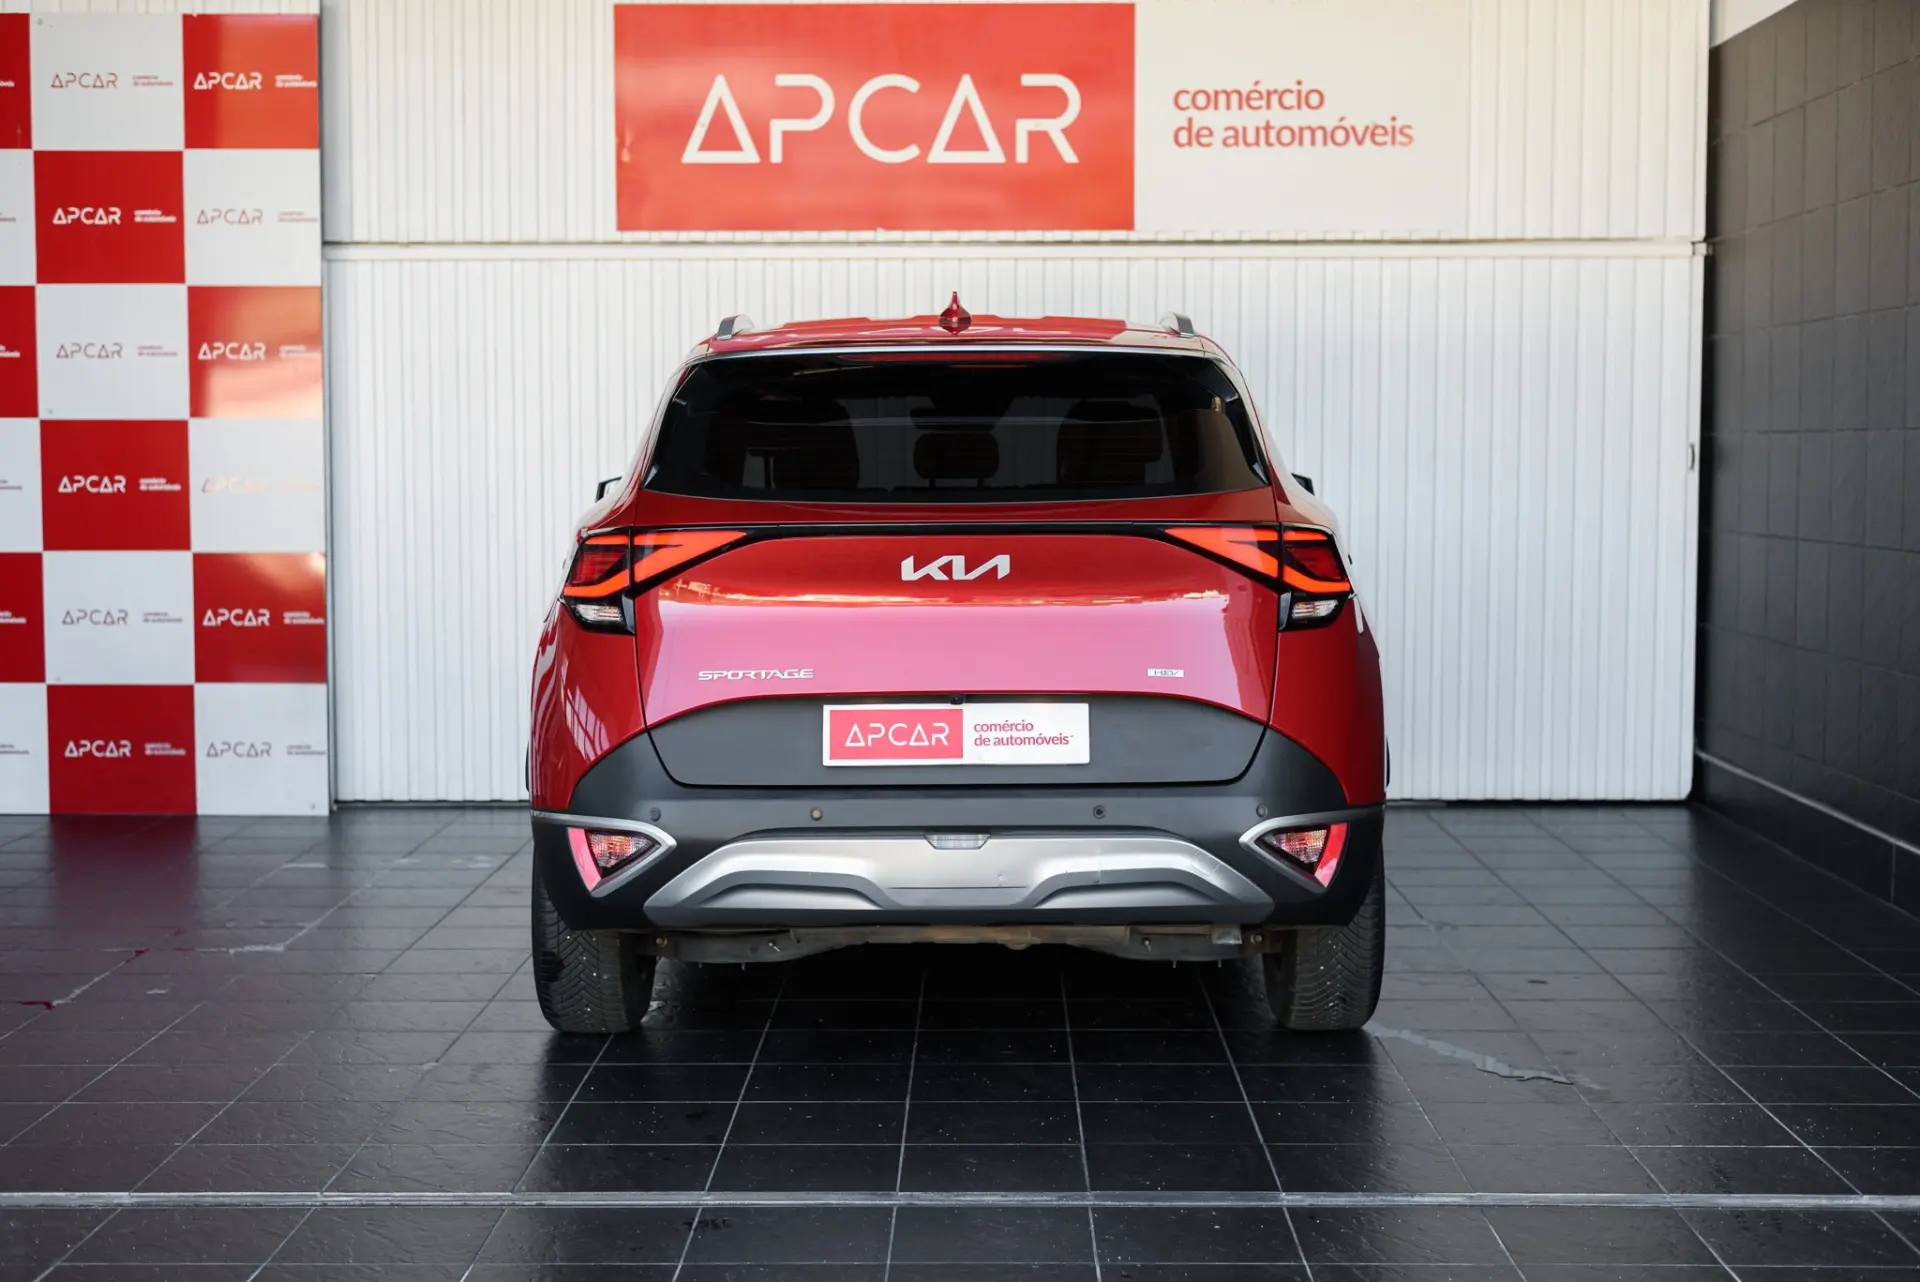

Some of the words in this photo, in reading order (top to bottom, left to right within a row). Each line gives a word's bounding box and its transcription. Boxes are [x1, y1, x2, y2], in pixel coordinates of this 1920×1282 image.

[193, 72, 263, 90] APCAR
[1173, 79, 1325, 112] comércio
[681, 73, 1082, 164] APCAR
[1173, 117, 1214, 148] de
[1221, 115, 1415, 148] automóveis
[52, 206, 122, 225] APCAR
[197, 341, 267, 360] APCAR
[58, 474, 127, 493] APCAR
[901, 554, 1011, 581] KIA
[202, 608, 271, 627] APCAR
[698, 668, 814, 681] SPORTAGE
[844, 722, 950, 747] APCAR
[973, 719, 1034, 733] comércio
[64, 739, 132, 758] APCAR
[974, 734, 991, 747] de
[993, 732, 1070, 746] automóveis
